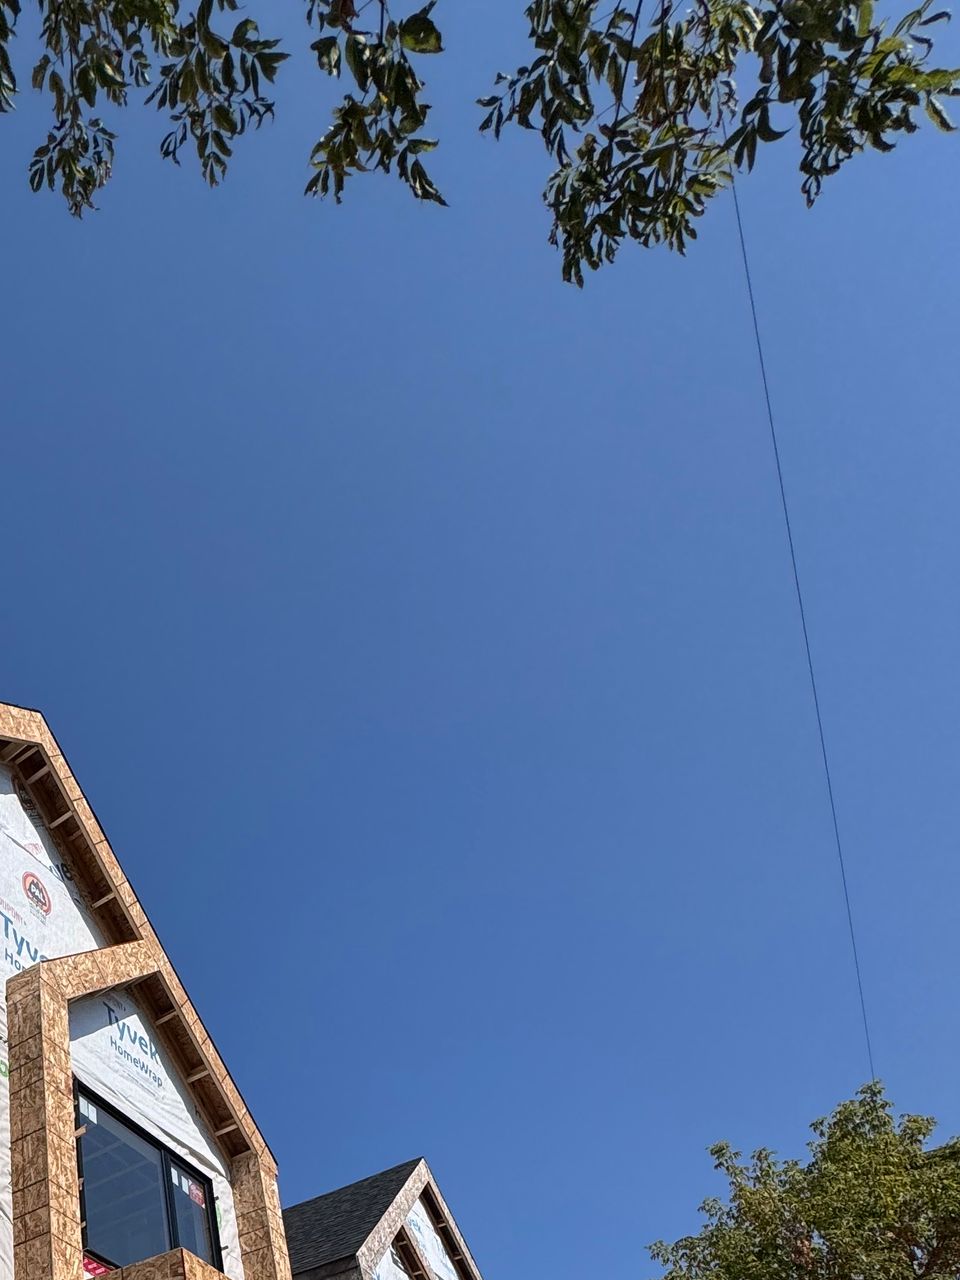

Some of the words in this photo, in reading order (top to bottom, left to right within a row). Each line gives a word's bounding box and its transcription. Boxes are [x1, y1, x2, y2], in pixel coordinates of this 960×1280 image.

[0, 911, 50, 963] Tyv
[5, 948, 27, 971] Ho
[103, 1001, 159, 1065] Tyvek
[110, 1036, 163, 1088] HomeWrap
